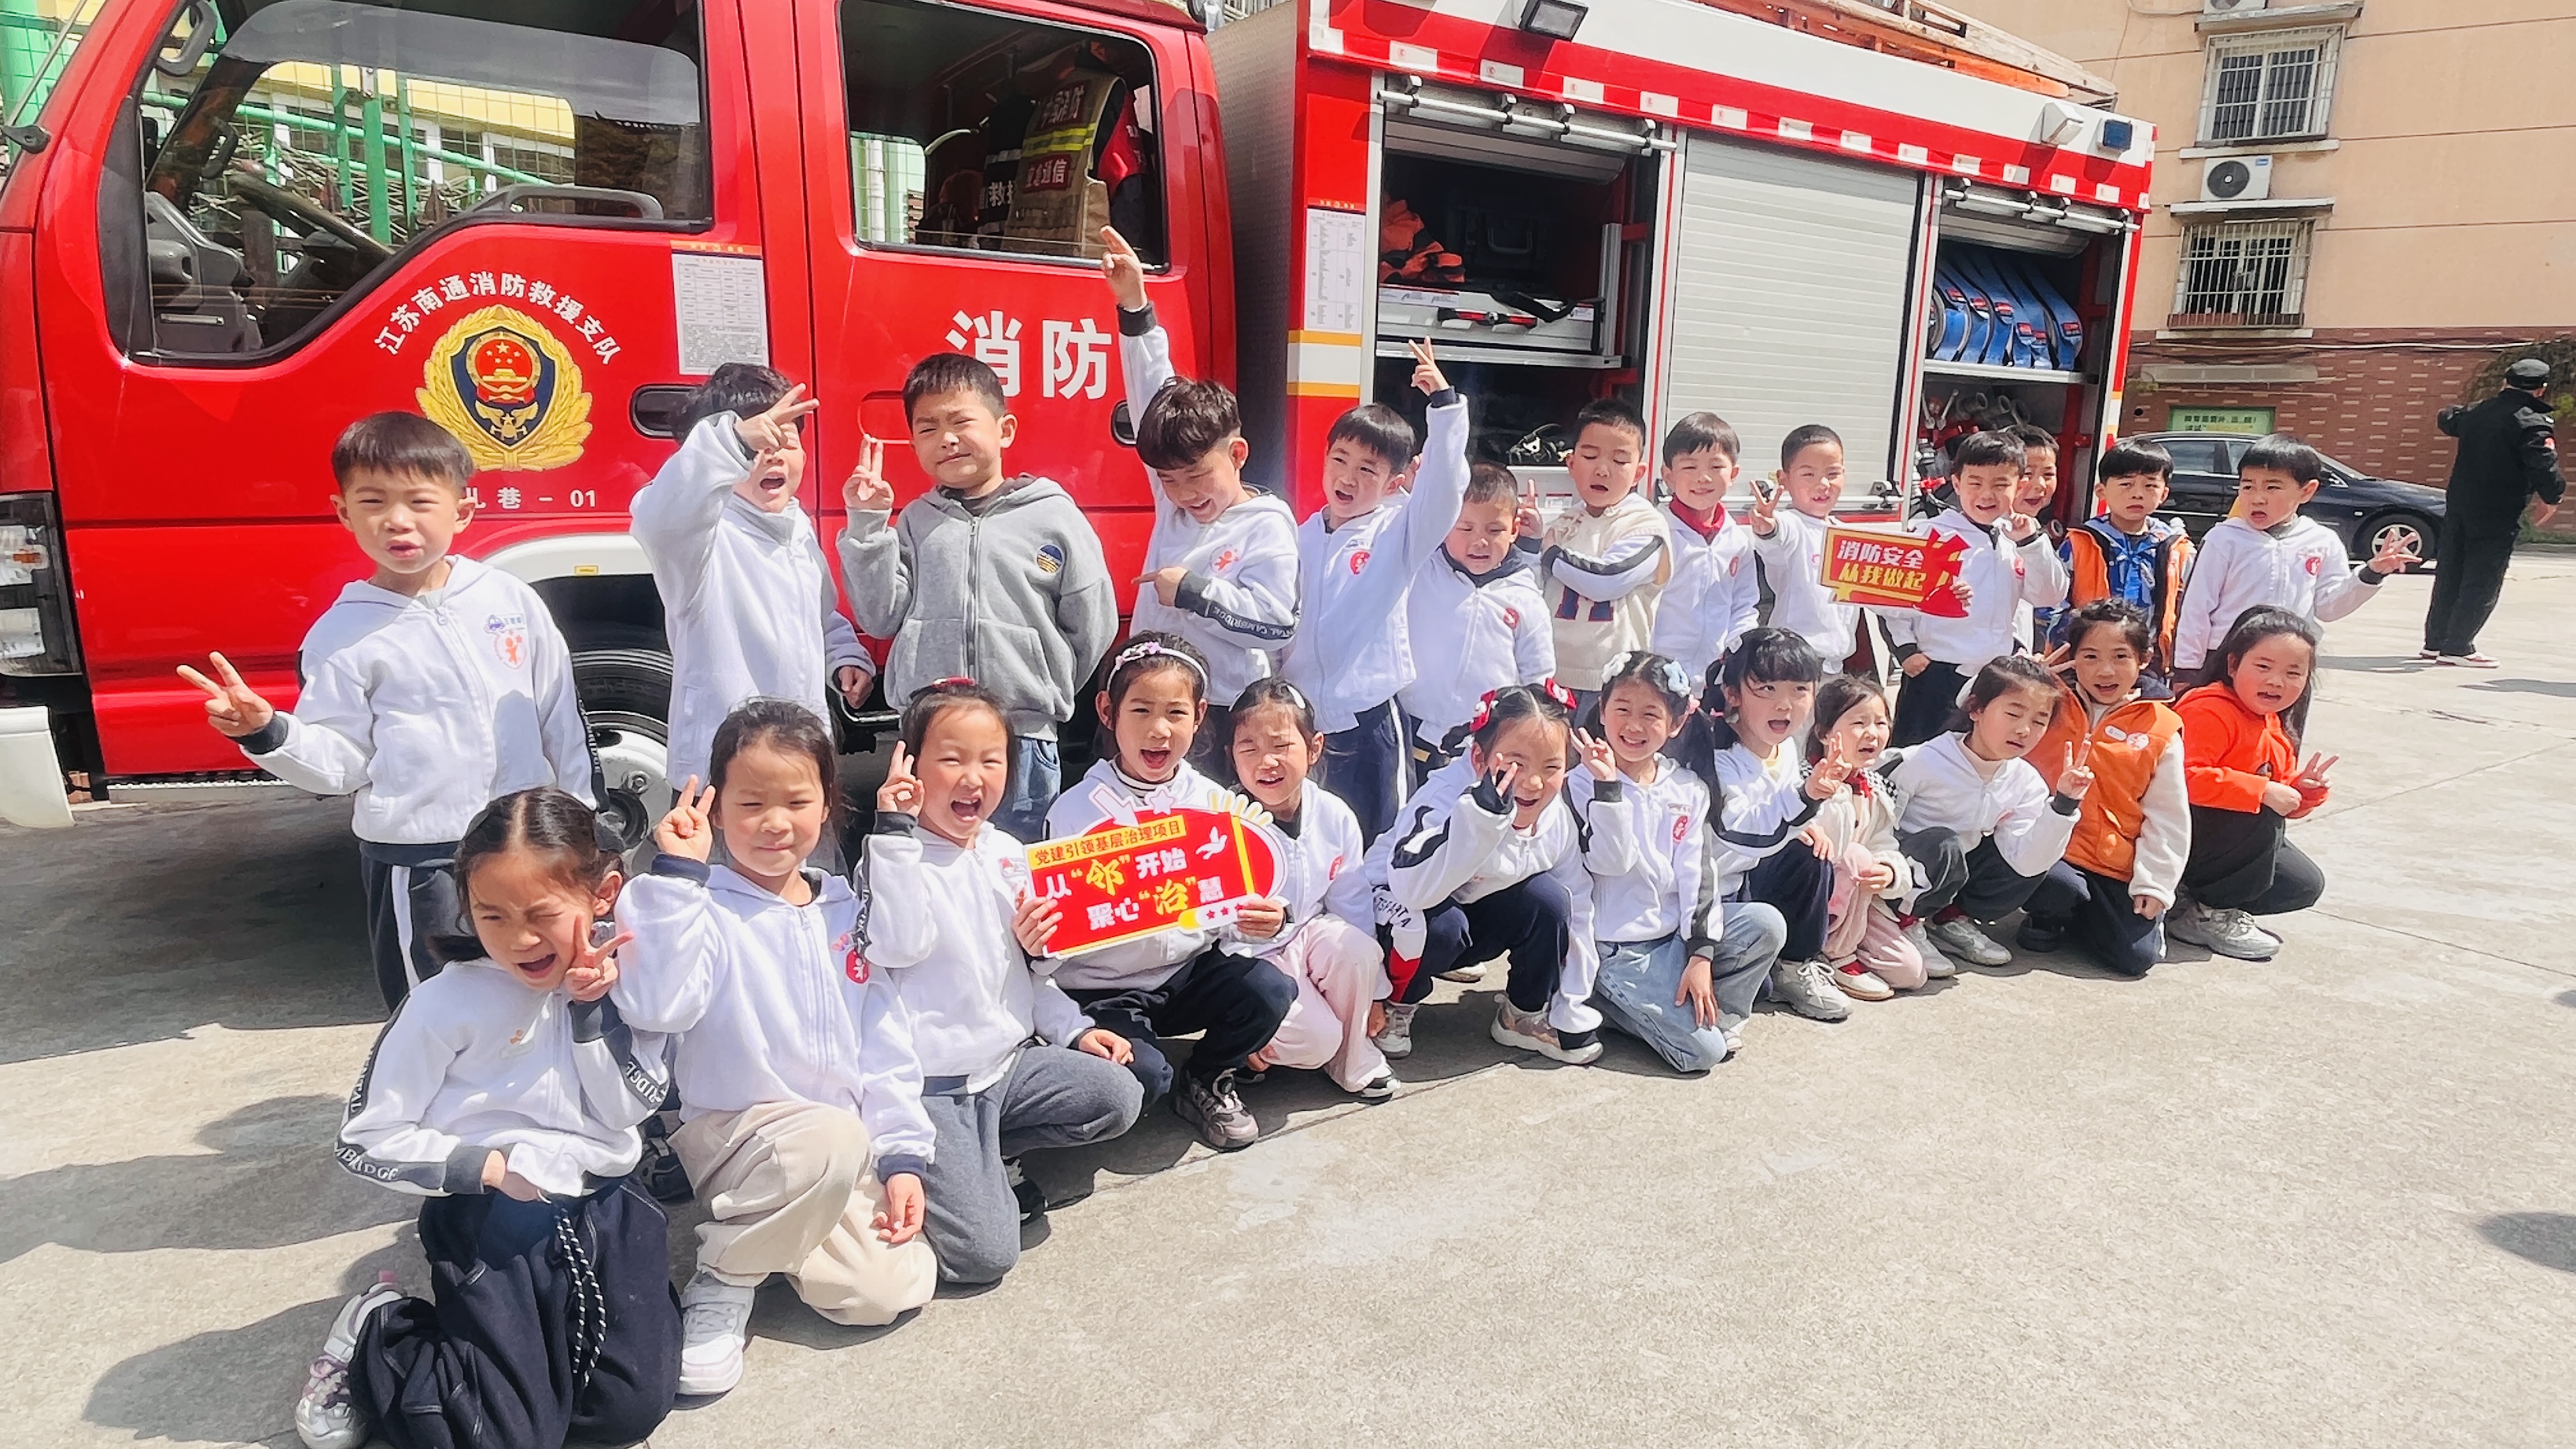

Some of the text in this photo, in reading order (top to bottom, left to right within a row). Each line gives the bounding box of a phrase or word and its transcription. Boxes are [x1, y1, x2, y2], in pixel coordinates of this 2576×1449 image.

[374, 270, 621, 365] 江苏南通消防救援支队
[945, 309, 1112, 400] 消防
[1836, 539, 1925, 570] 消防安全
[1837, 562, 1927, 591] 从我做起
[1035, 820, 1181, 866] 党建引领基层治理项目
